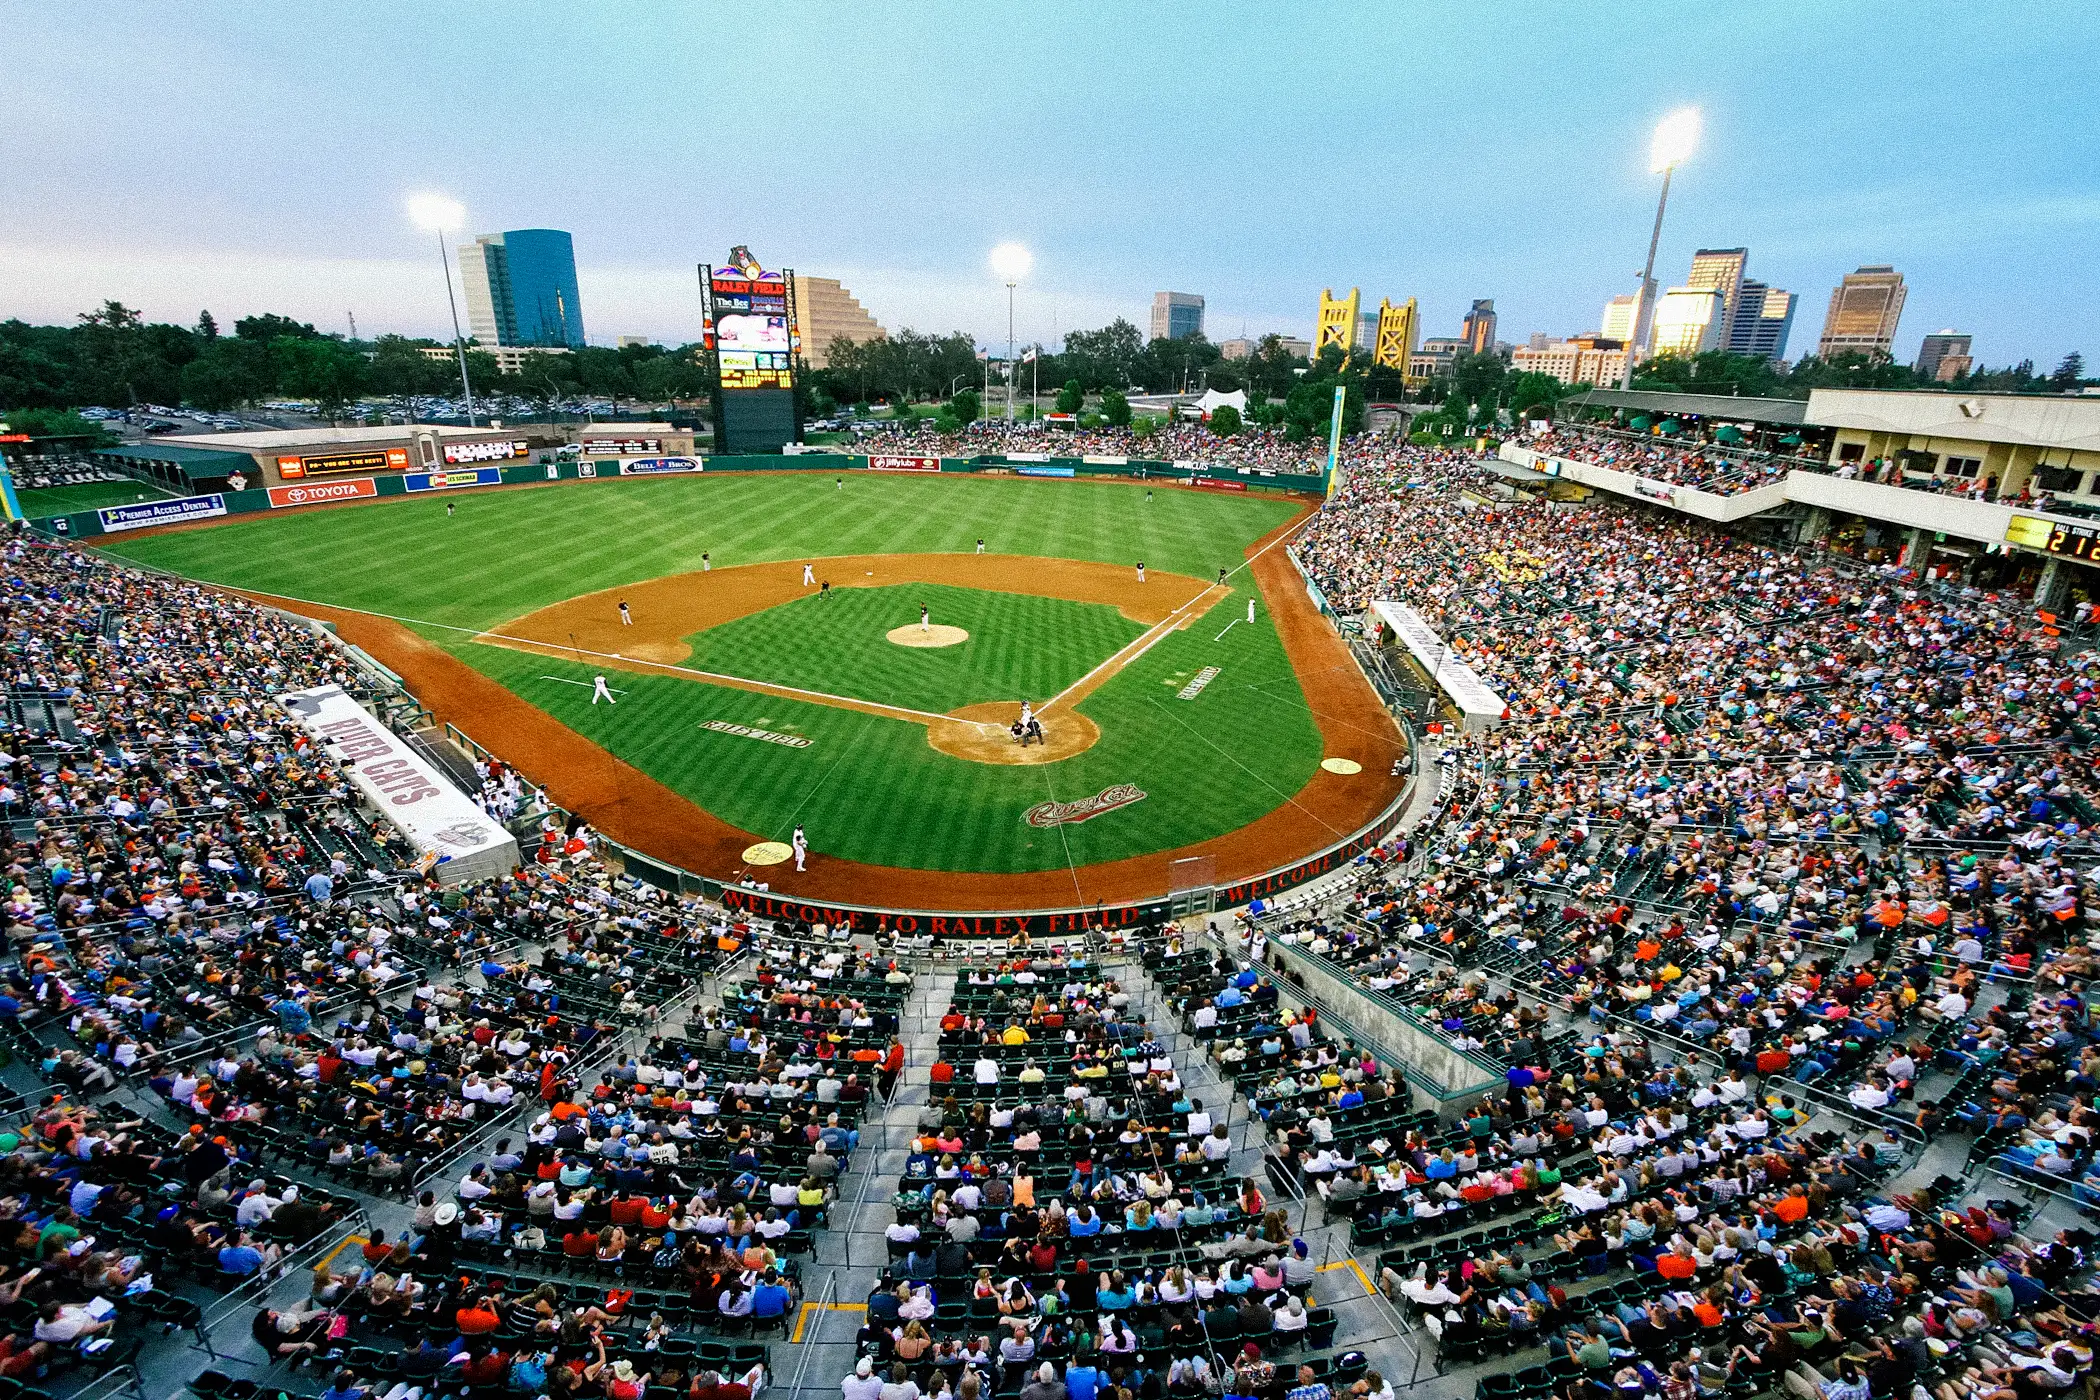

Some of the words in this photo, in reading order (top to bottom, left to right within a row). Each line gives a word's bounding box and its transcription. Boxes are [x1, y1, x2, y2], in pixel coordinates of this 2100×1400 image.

[712, 280, 750, 294] RALEY
[752, 281, 785, 295] FIELD
[716, 297, 732, 307] The
[733, 298, 749, 307] Bee
[633, 462, 656, 470] BELL
[308, 484, 359, 498] TOYOTA
[119, 509, 153, 520] PREMIER
[153, 505, 182, 515] ACCESS
[182, 501, 210, 512] DENTAL
[56, 522, 67, 531] 42
[2054, 523, 2070, 533] BALL
[2072, 527, 2095, 538] STRIKE
[2050, 531, 2066, 551] 2
[2075, 537, 2087, 555] 1
[702, 720, 755, 736] RALEY
[760, 732, 811, 747] FIELD
[317, 717, 394, 763] RIVER
[361, 759, 441, 806] CATS
[1020, 797, 1096, 829] River
[1097, 783, 1140, 804] Cats
[1227, 857, 1332, 903] WELCOME
[1338, 842, 1360, 862] TO
[723, 889, 865, 930] WELCOME
[874, 914, 918, 933] TO
[931, 916, 1033, 937] RALEY
[1049, 907, 1140, 933] FIELD
